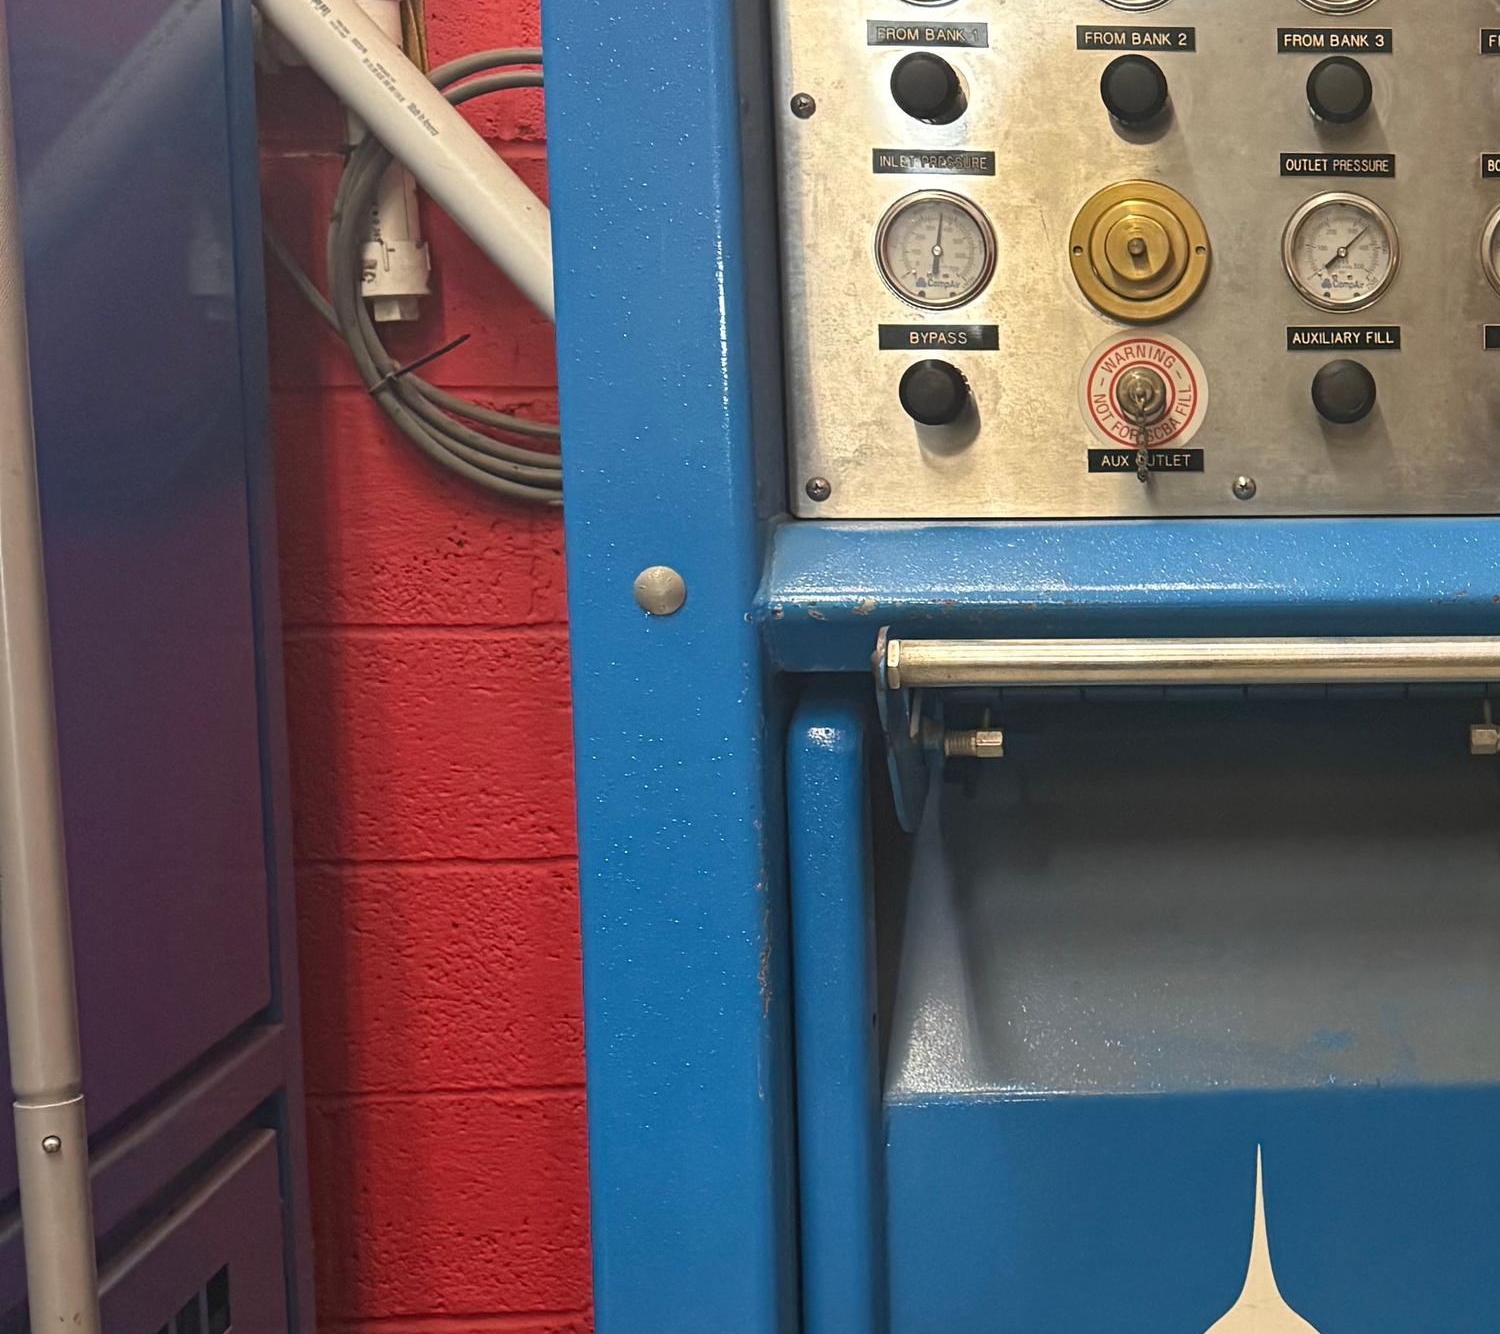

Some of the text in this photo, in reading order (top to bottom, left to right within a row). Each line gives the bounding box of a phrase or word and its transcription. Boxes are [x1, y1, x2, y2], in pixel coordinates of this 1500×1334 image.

[876, 26, 979, 43] FROM BANK 1
[1084, 31, 1187, 46] FROM BANK 2
[1283, 34, 1385, 47] FROM BANK 3
[879, 155, 988, 170] INLET PRESSURE
[1285, 158, 1390, 172] OUTLET PRESSURE
[909, 331, 968, 344] BYPASS
[1292, 331, 1395, 344] AUXILIARY FILL
[1100, 344, 1176, 373] WARNING
[1093, 393, 1115, 422] NOT
[1111, 421, 1139, 441] FOR
[1176, 384, 1192, 417] FILL
[1101, 453, 1191, 468] AUX UTLET
